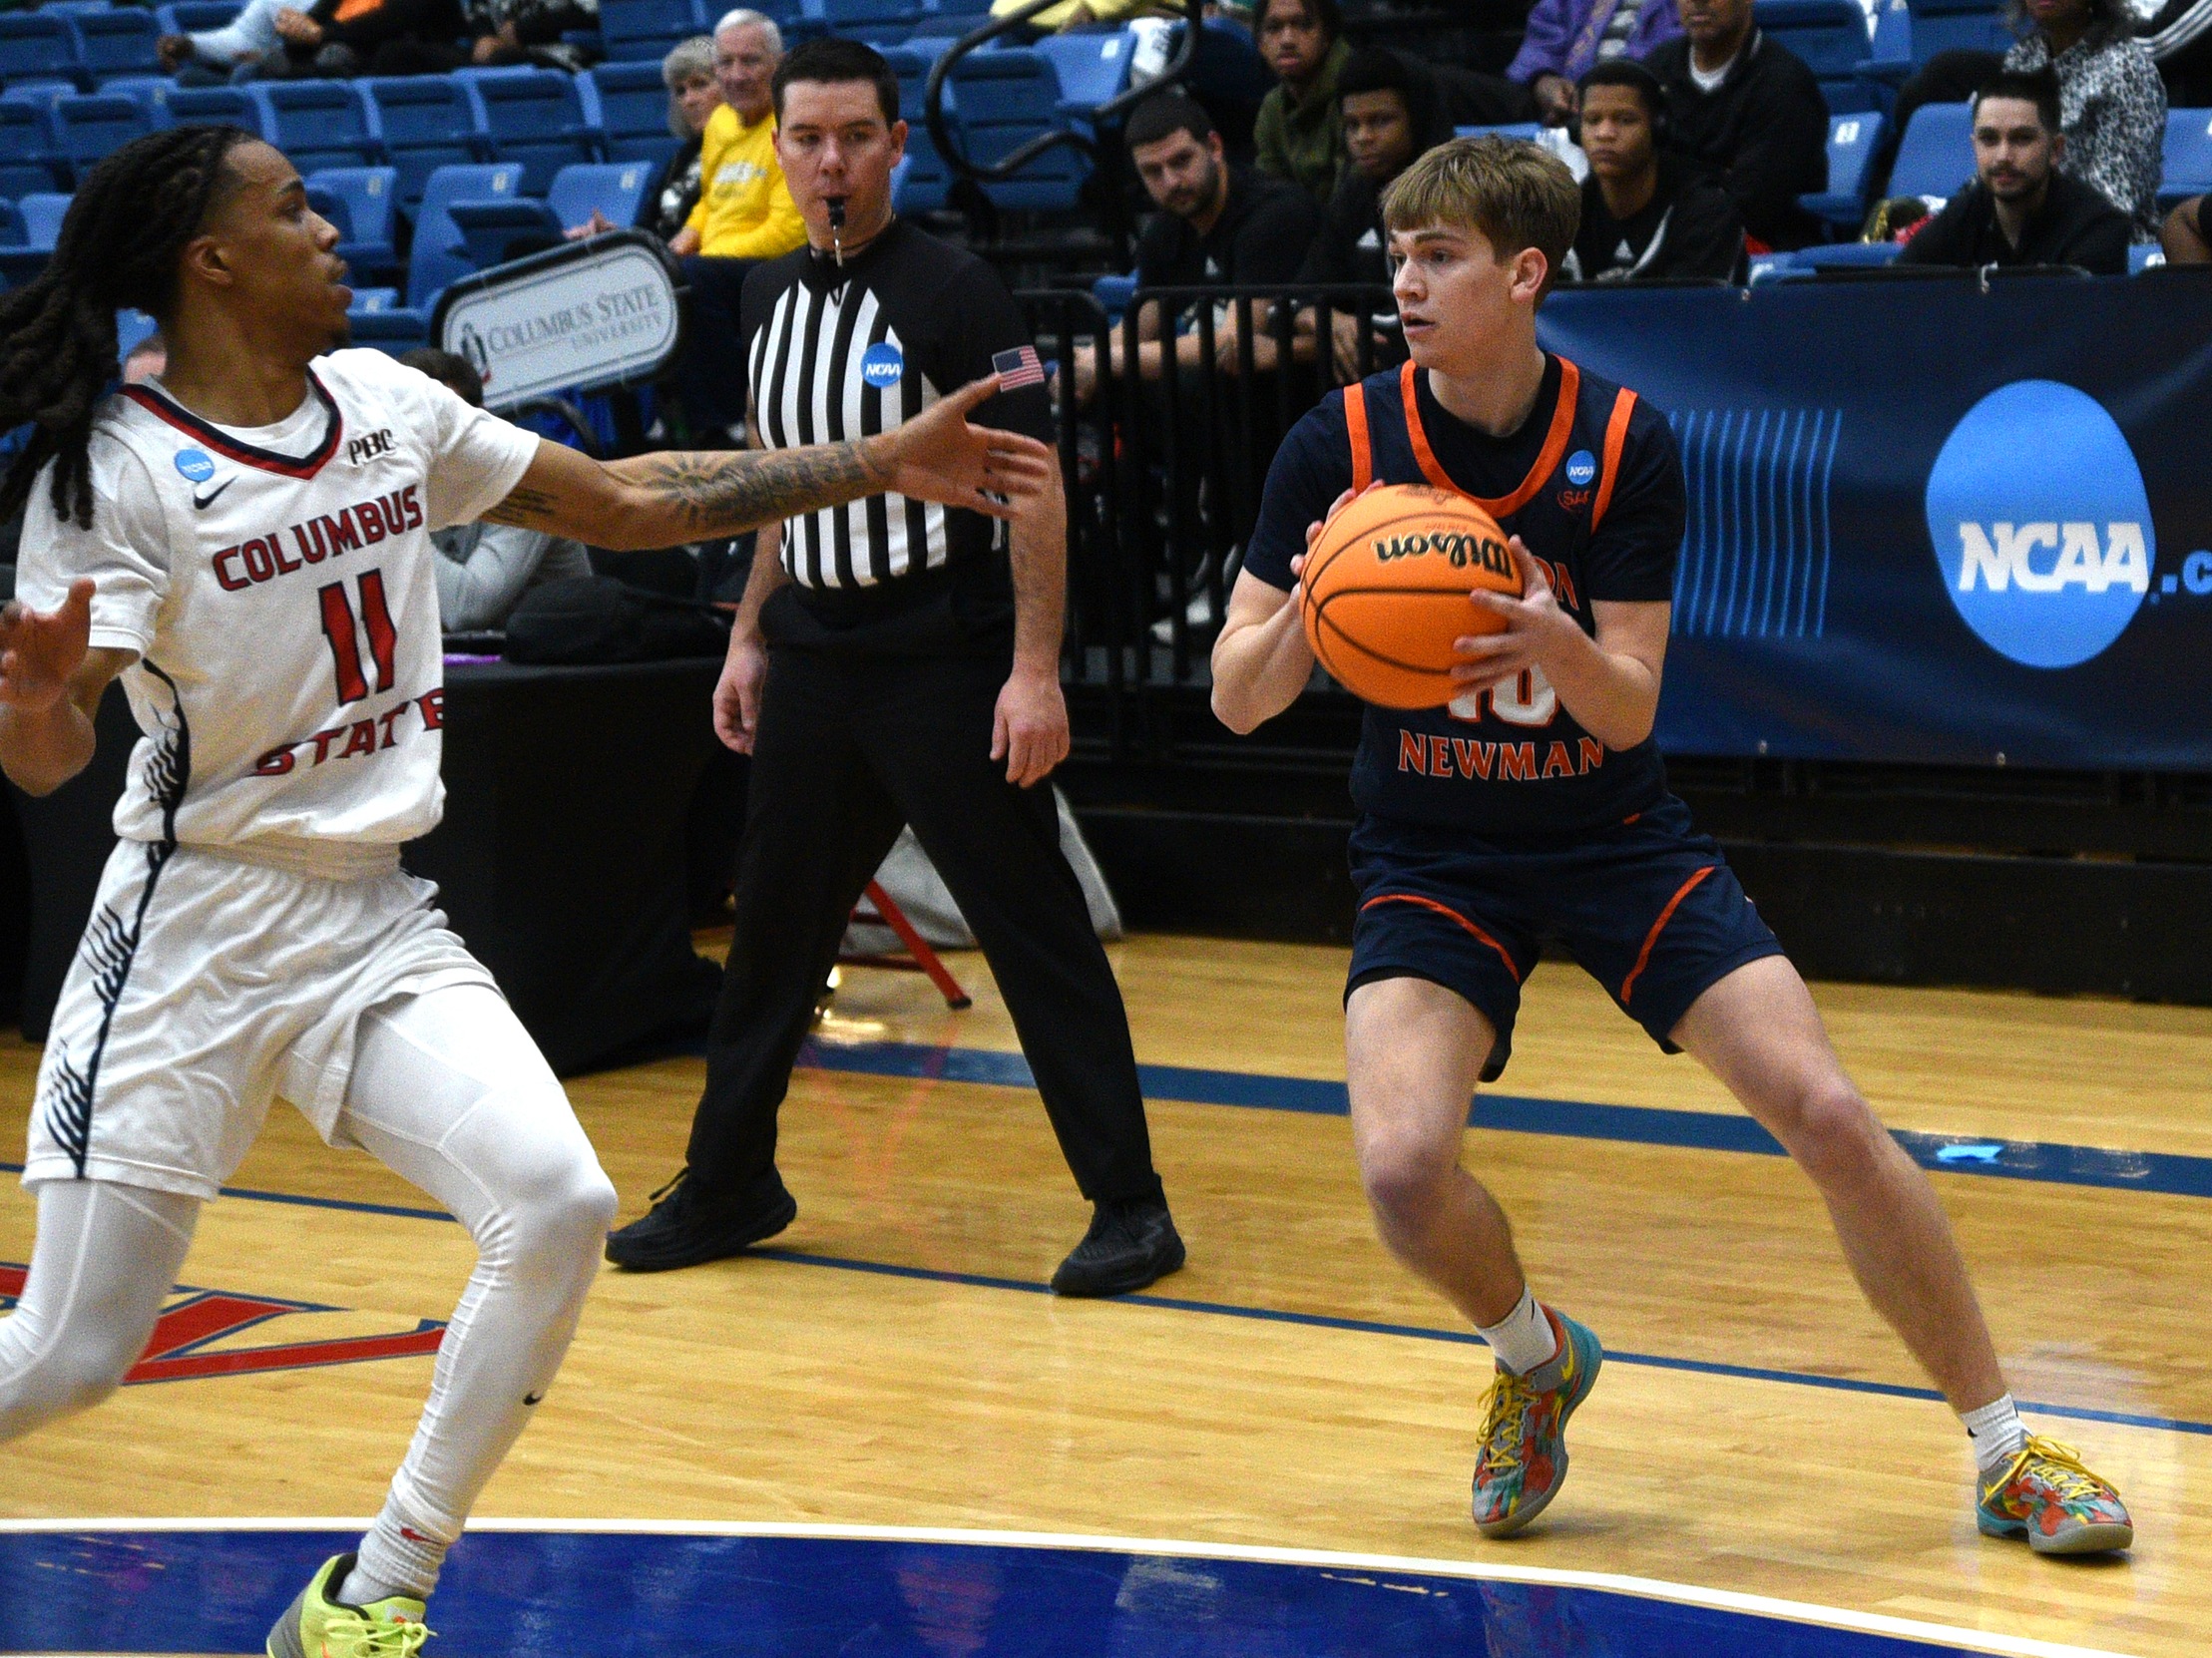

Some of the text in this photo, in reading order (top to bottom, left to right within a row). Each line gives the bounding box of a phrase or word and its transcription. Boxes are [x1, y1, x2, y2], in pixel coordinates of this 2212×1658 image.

[598, 283, 659, 323] STATE
[866, 363, 901, 377] NCAA
[349, 428, 395, 465] PBC
[1569, 466, 1594, 478] NCAA
[212, 483, 424, 592] COLUMBUS
[1373, 532, 1514, 581] Wilson
[317, 567, 396, 707] 11
[245, 686, 444, 777] STATE
[1398, 728, 1604, 782] NEWMAN
